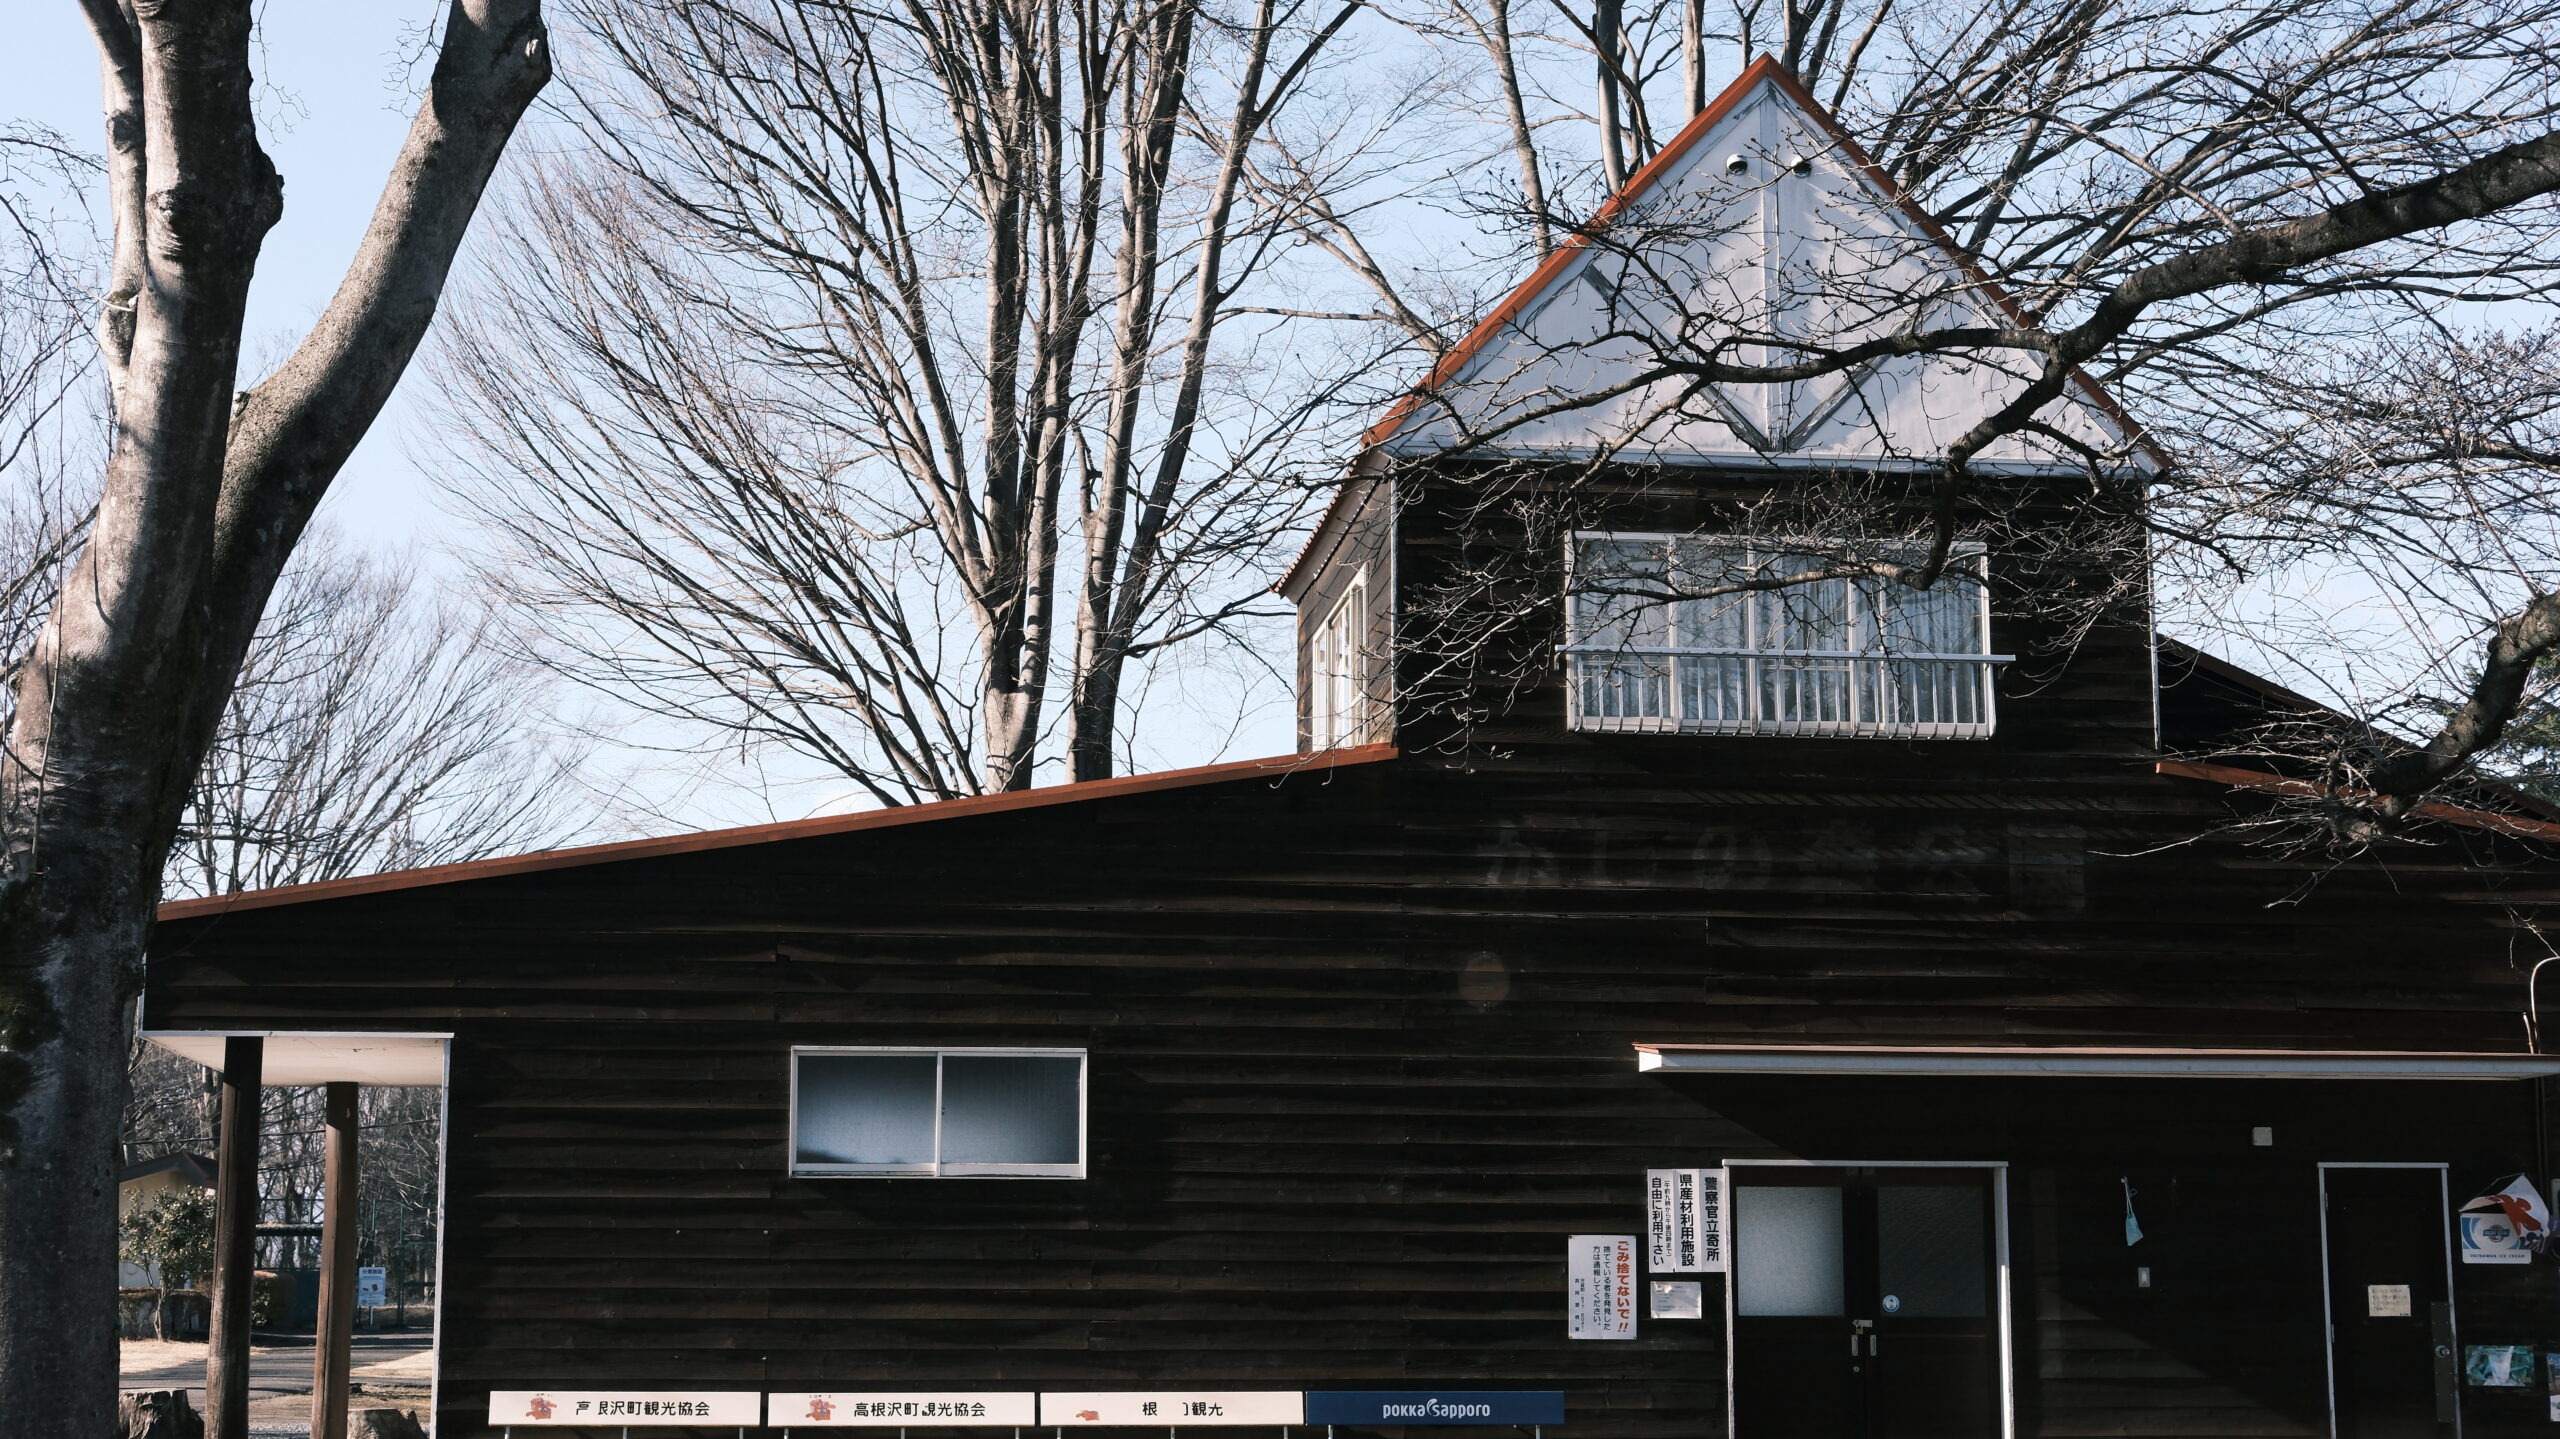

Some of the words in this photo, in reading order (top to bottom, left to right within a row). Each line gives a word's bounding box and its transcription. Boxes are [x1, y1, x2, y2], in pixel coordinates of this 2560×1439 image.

[1651, 1177, 1664, 1266] 自由に利用下さい
[1679, 1173, 1695, 1267] 県産材利用施設
[1704, 1176, 1720, 1262] 警察官立寄所
[1592, 1245, 1602, 1327] 方は通報してください。
[1603, 1245, 1612, 1331] 捨てている者を発見した
[1616, 1240, 1630, 1333] ごみ捨てないで!!
